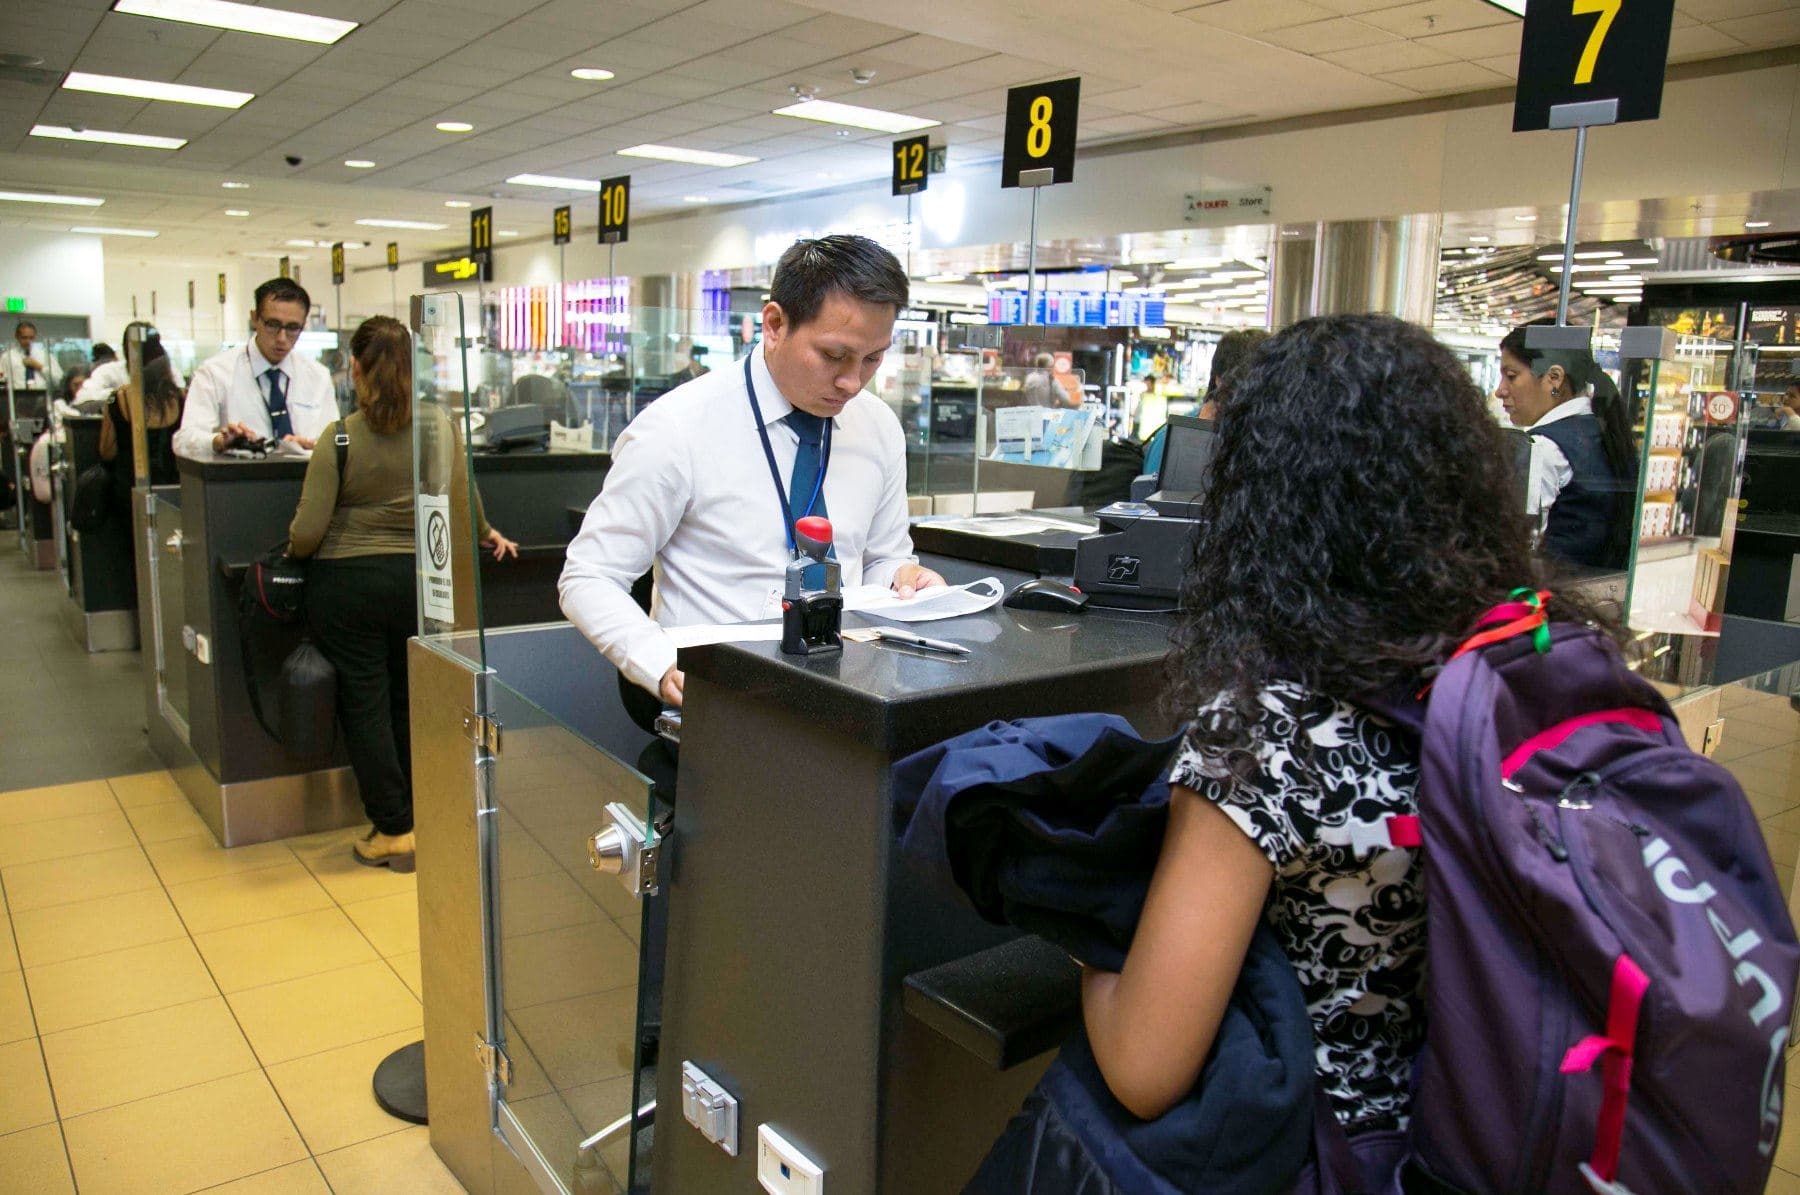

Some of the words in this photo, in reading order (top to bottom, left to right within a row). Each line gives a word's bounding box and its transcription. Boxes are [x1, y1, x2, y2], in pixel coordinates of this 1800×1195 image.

[1572, 0, 1622, 84] 7
[1027, 95, 1053, 158] 8
[896, 143, 924, 180] 12
[555, 210, 569, 235] 15
[602, 184, 626, 226] 10
[473, 214, 489, 249] 11
